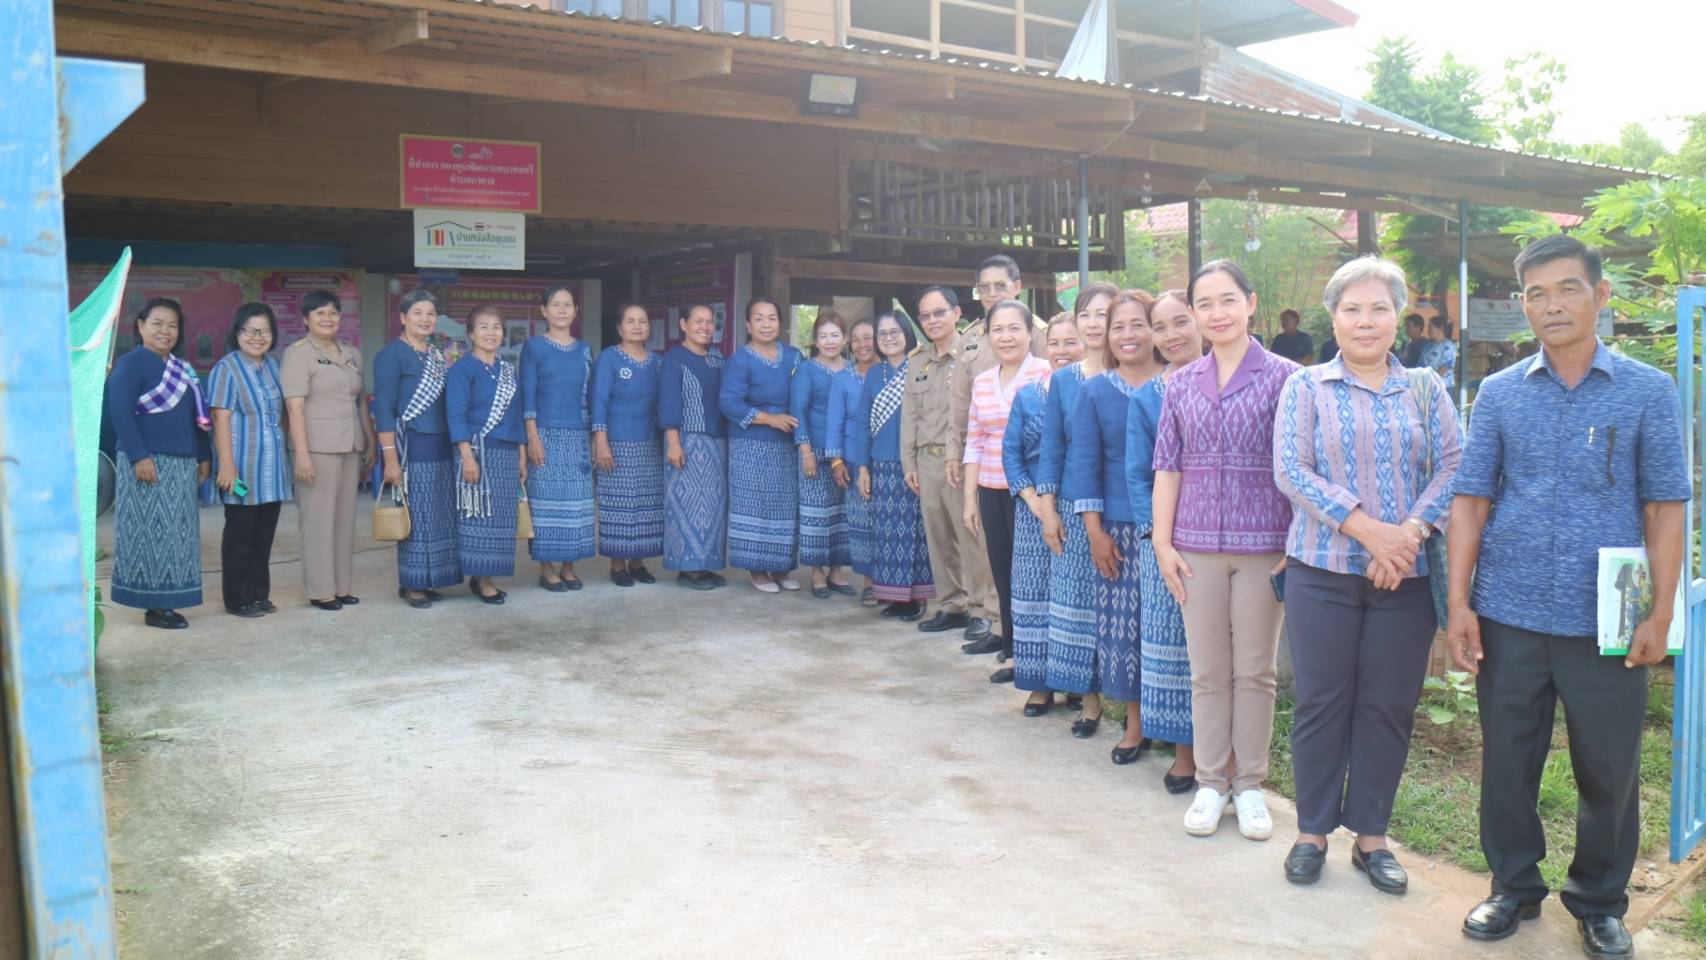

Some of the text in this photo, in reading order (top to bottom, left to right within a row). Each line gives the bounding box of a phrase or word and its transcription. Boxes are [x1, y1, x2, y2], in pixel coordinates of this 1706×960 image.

[456, 230, 516, 246] บ้านหนังสือชุมชน
